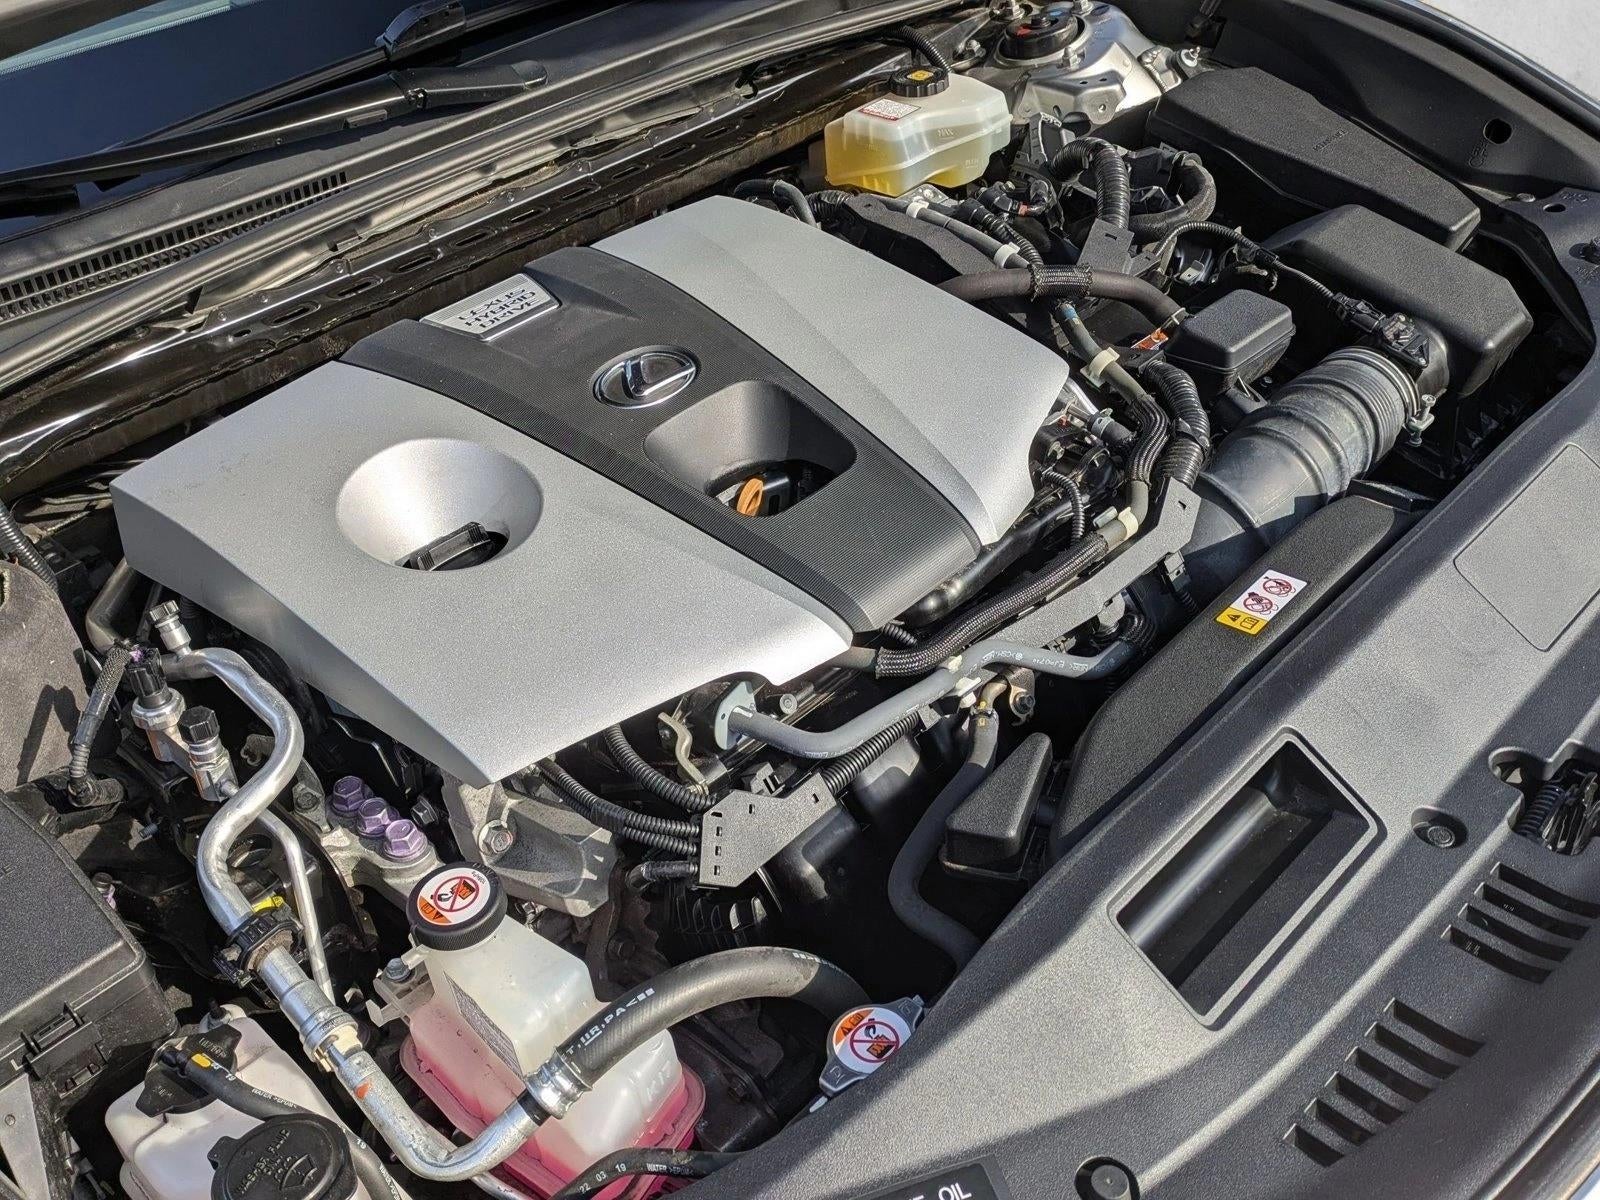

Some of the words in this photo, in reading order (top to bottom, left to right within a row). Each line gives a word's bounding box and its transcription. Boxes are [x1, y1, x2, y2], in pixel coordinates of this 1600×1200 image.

[458, 286, 526, 320] LEXUS
[464, 291, 536, 327] HYBRID
[479, 298, 539, 329] DRIVE
[595, 1170, 607, 1182] 03
[615, 1162, 627, 1173] 19
[646, 1162, 667, 1173] WATER
[938, 1182, 972, 1200] OIL
